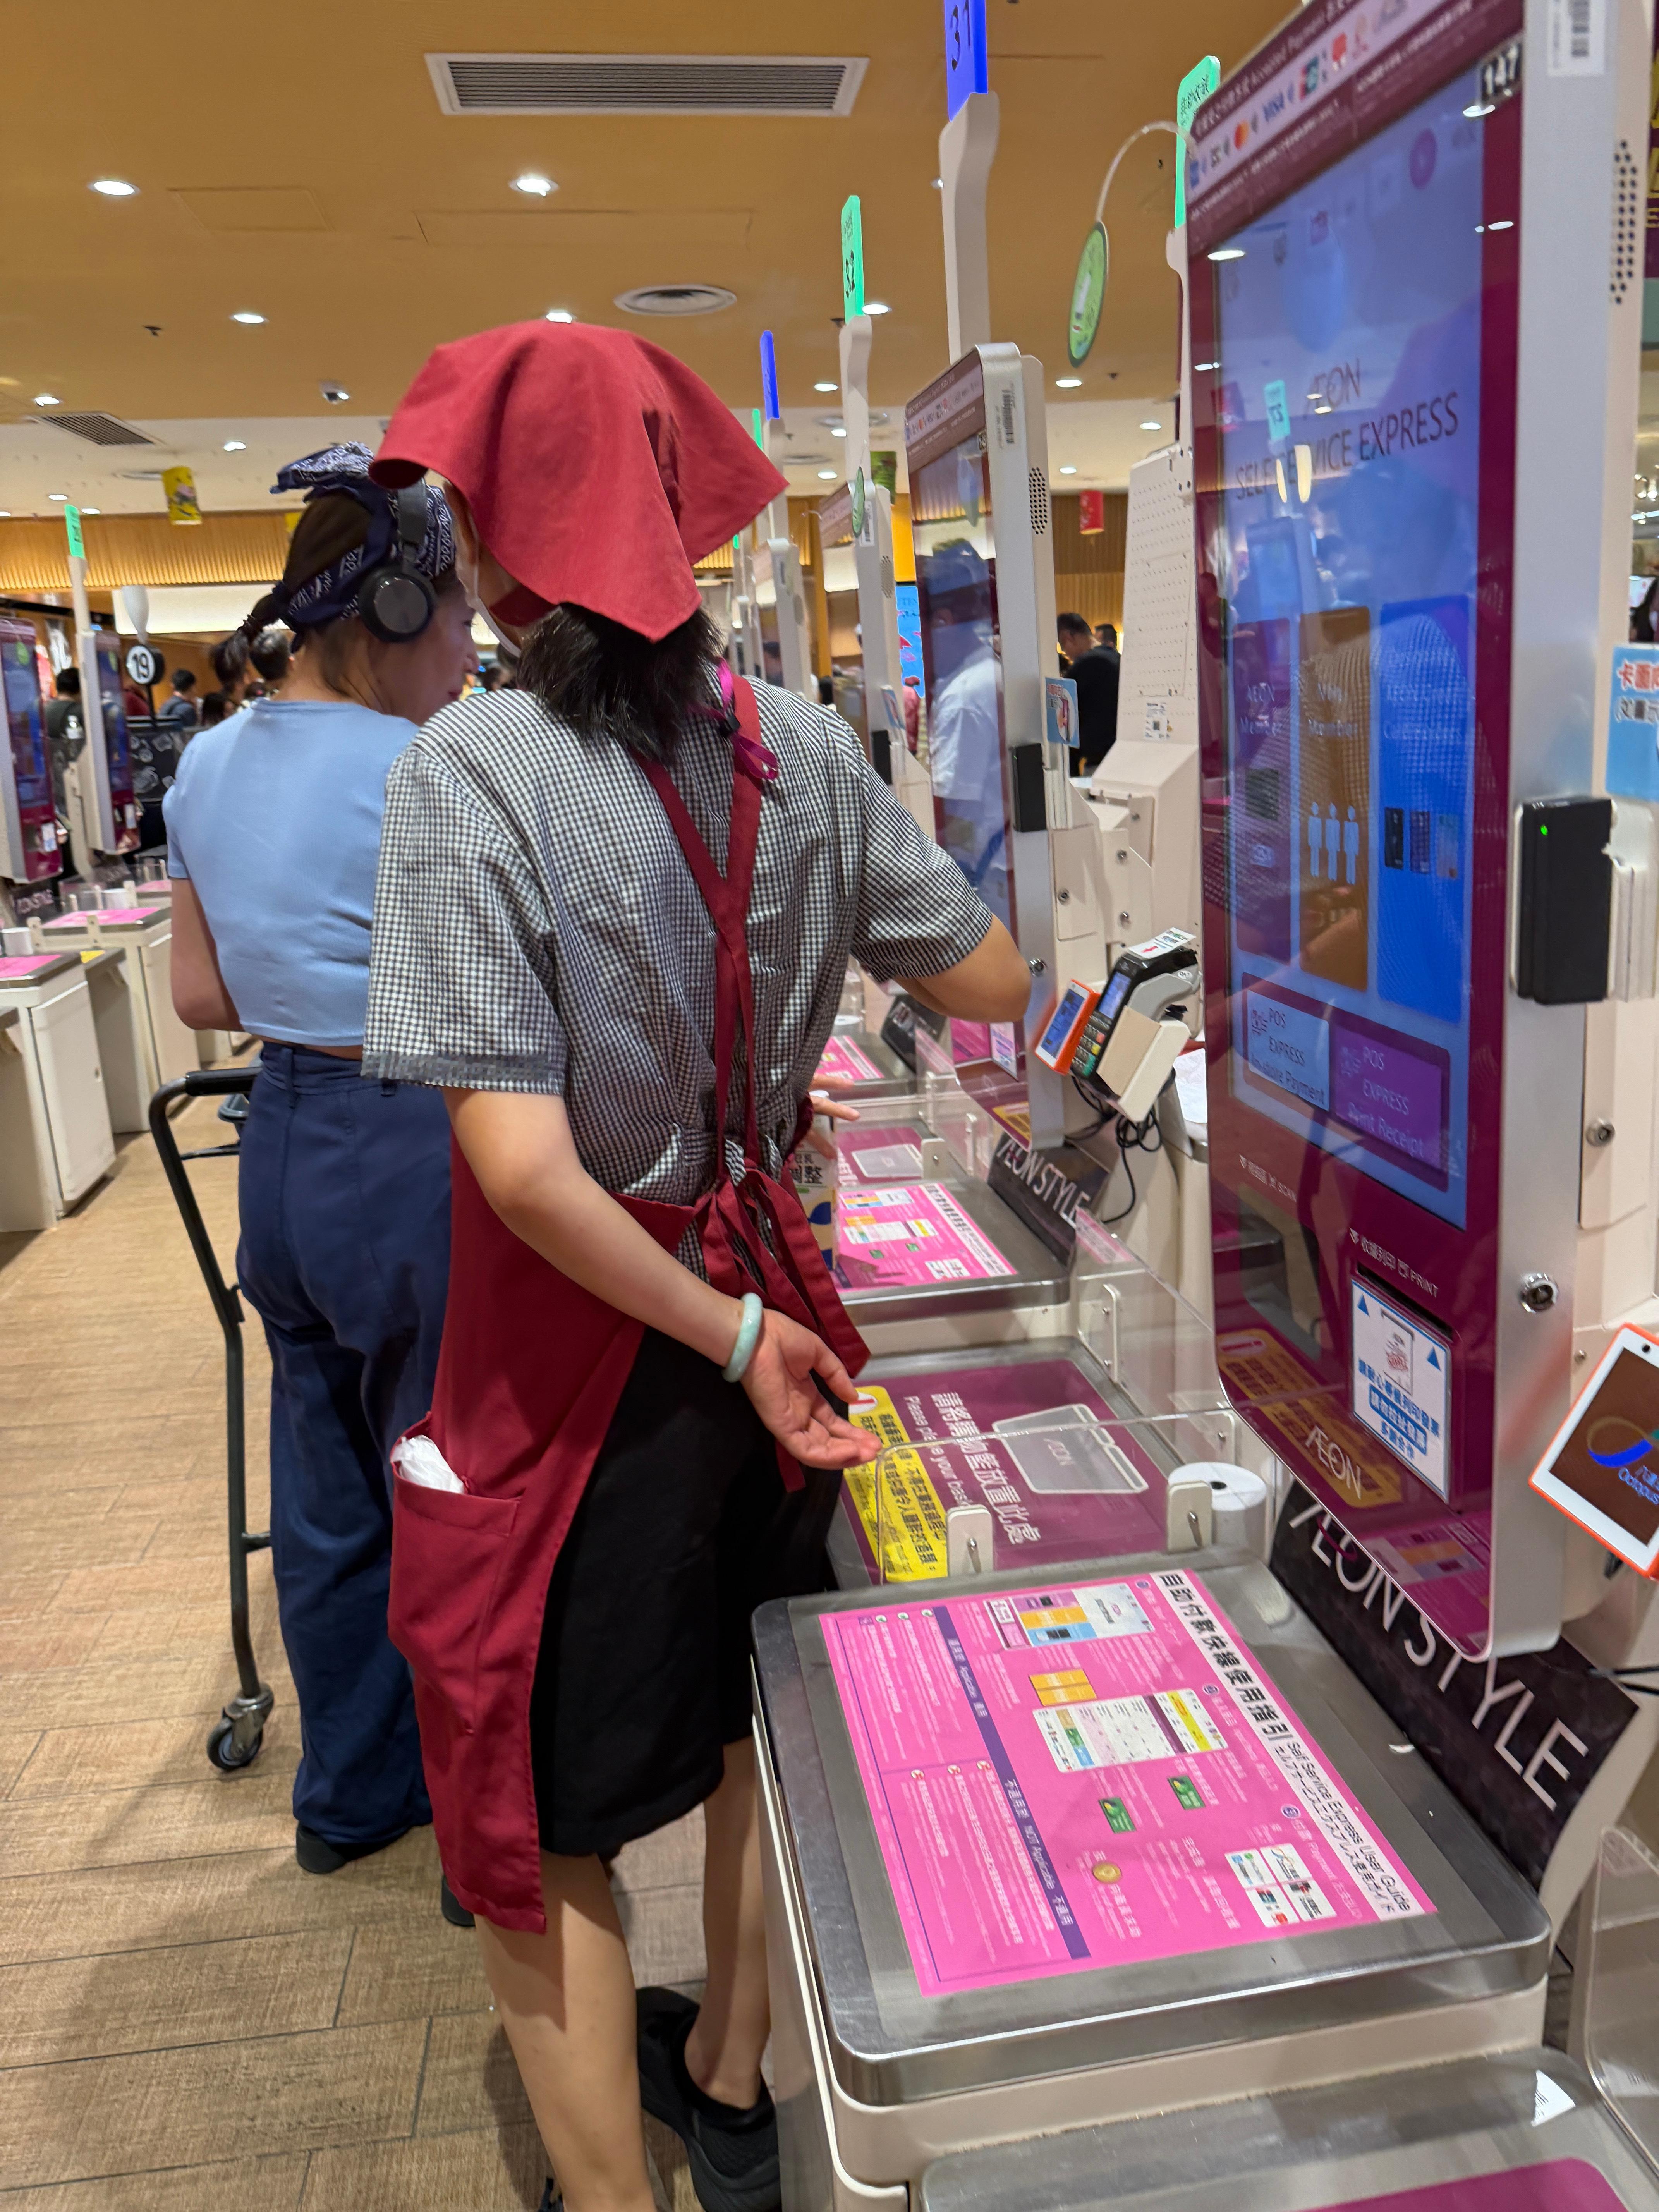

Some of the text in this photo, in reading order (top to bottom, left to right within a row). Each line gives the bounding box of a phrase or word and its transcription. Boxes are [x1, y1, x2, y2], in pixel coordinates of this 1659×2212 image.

[1358, 390, 1459, 462] EXPRESS
[130, 653, 149, 678] 19
[903, 1396, 929, 1426] Please
[1161, 1573, 1294, 1740] 自助付款快線使用指引
[1299, 1761, 1337, 1800] Service
[1324, 1801, 1367, 1844] Express
[1357, 1844, 1389, 1875] User
[1378, 1875, 1415, 1912] Guide
